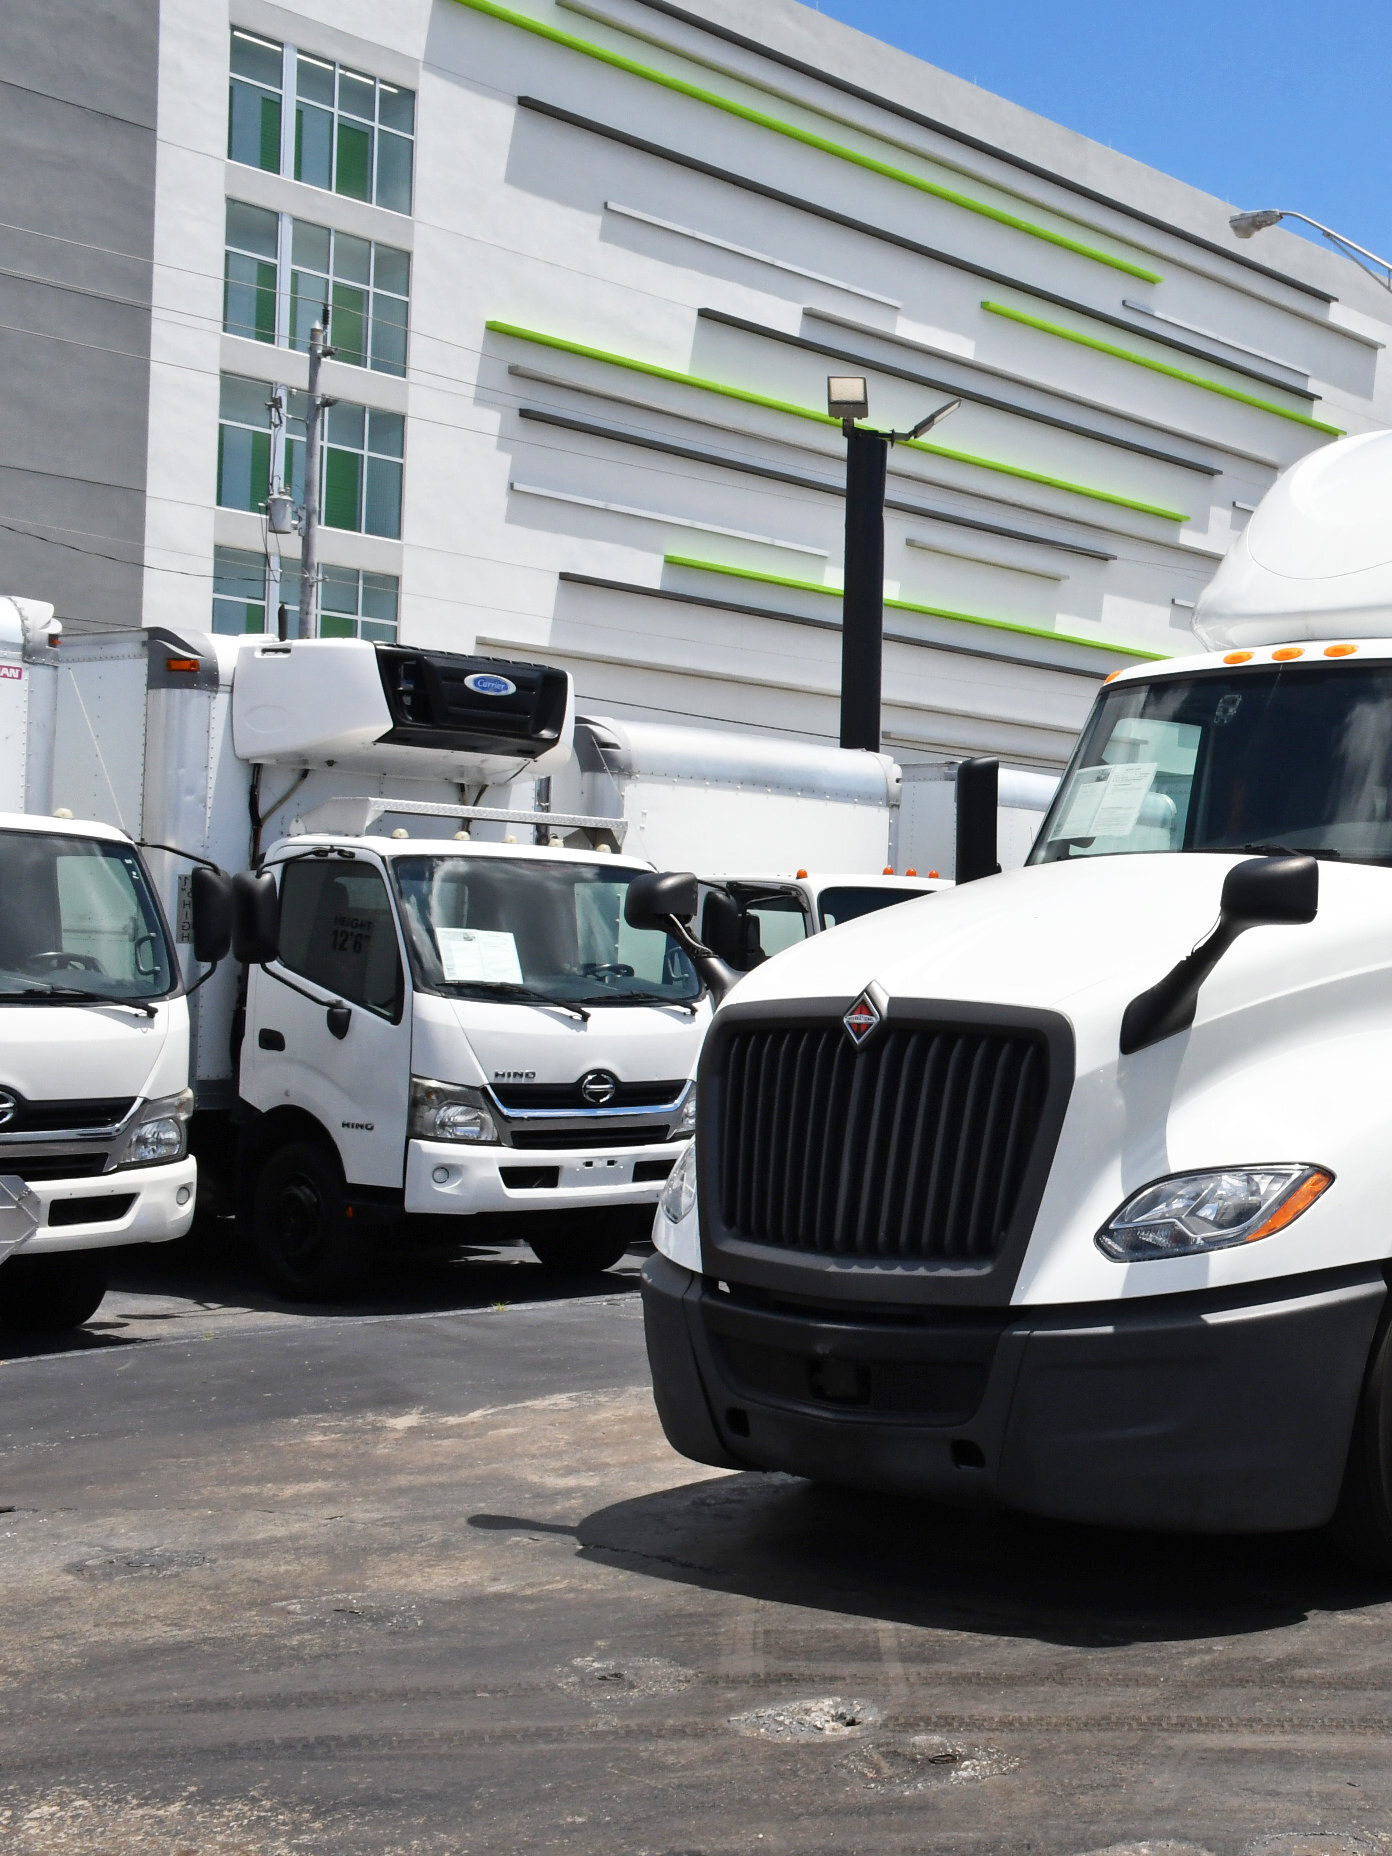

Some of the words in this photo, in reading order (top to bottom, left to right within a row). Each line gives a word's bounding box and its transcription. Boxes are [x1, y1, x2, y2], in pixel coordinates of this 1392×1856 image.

[477, 679, 507, 690] Carrier
[494, 1070, 537, 1080] HINO
[341, 1121, 375, 1131] HINO
